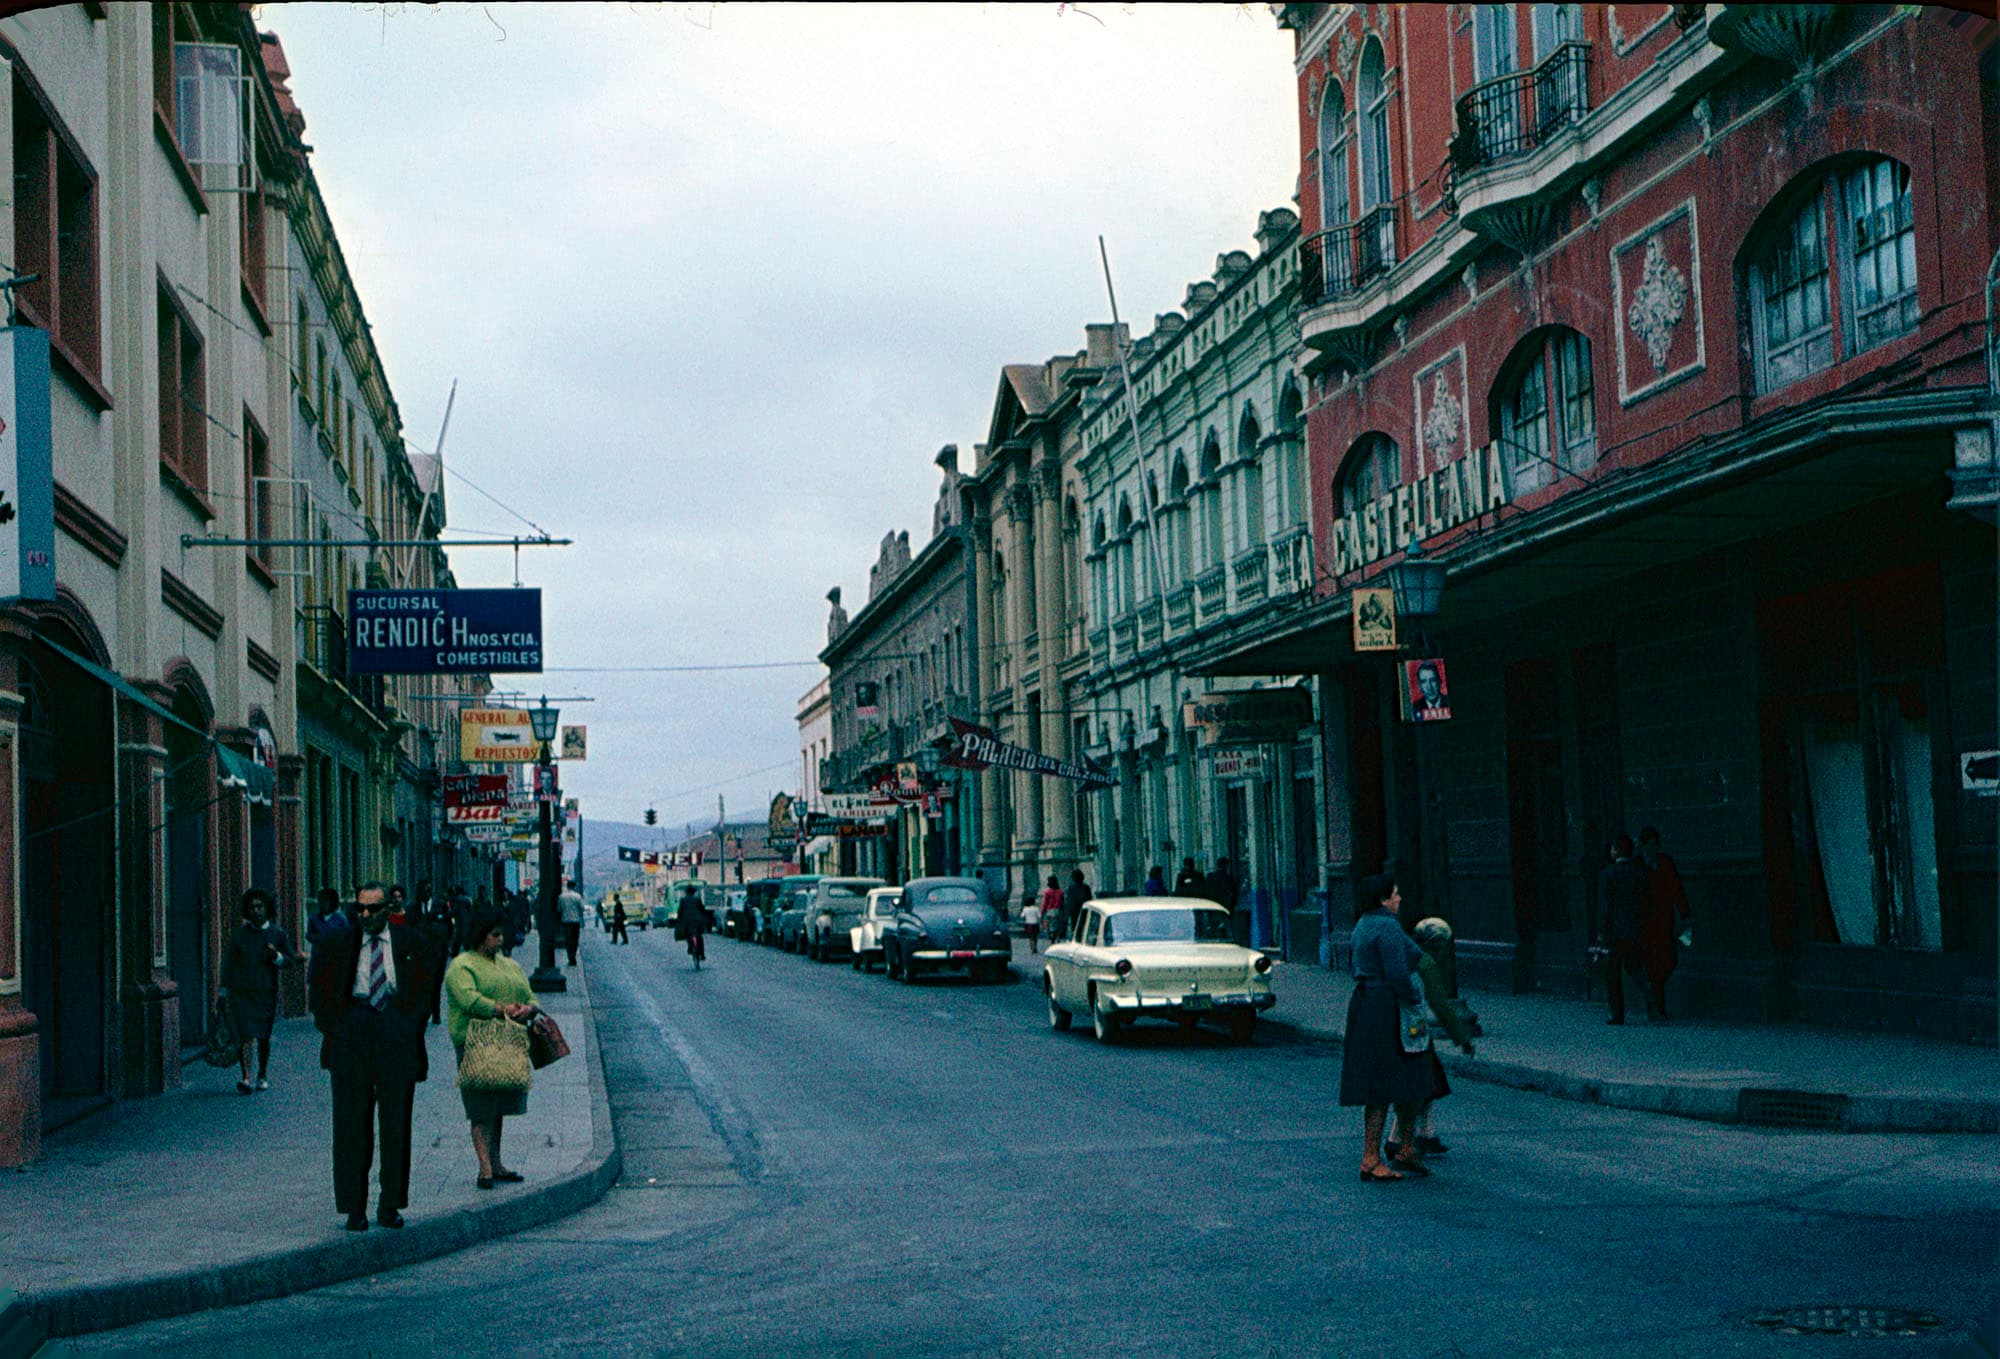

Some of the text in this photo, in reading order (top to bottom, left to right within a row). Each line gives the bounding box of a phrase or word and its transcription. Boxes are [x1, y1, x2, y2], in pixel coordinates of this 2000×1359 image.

[1290, 439, 1506, 593] LA CASTELLANA
[356, 597, 440, 610] SUCURSAL
[436, 651, 540, 666] COMESTIBLES
[463, 711, 508, 725] GENERAL
[474, 747, 538, 760] REPUESTOS
[962, 732, 1037, 770] PALACIO
[1057, 763, 1114, 785] CALZADO
[836, 809, 888, 817] CAMISERIA
[639, 851, 698, 866] FREI
